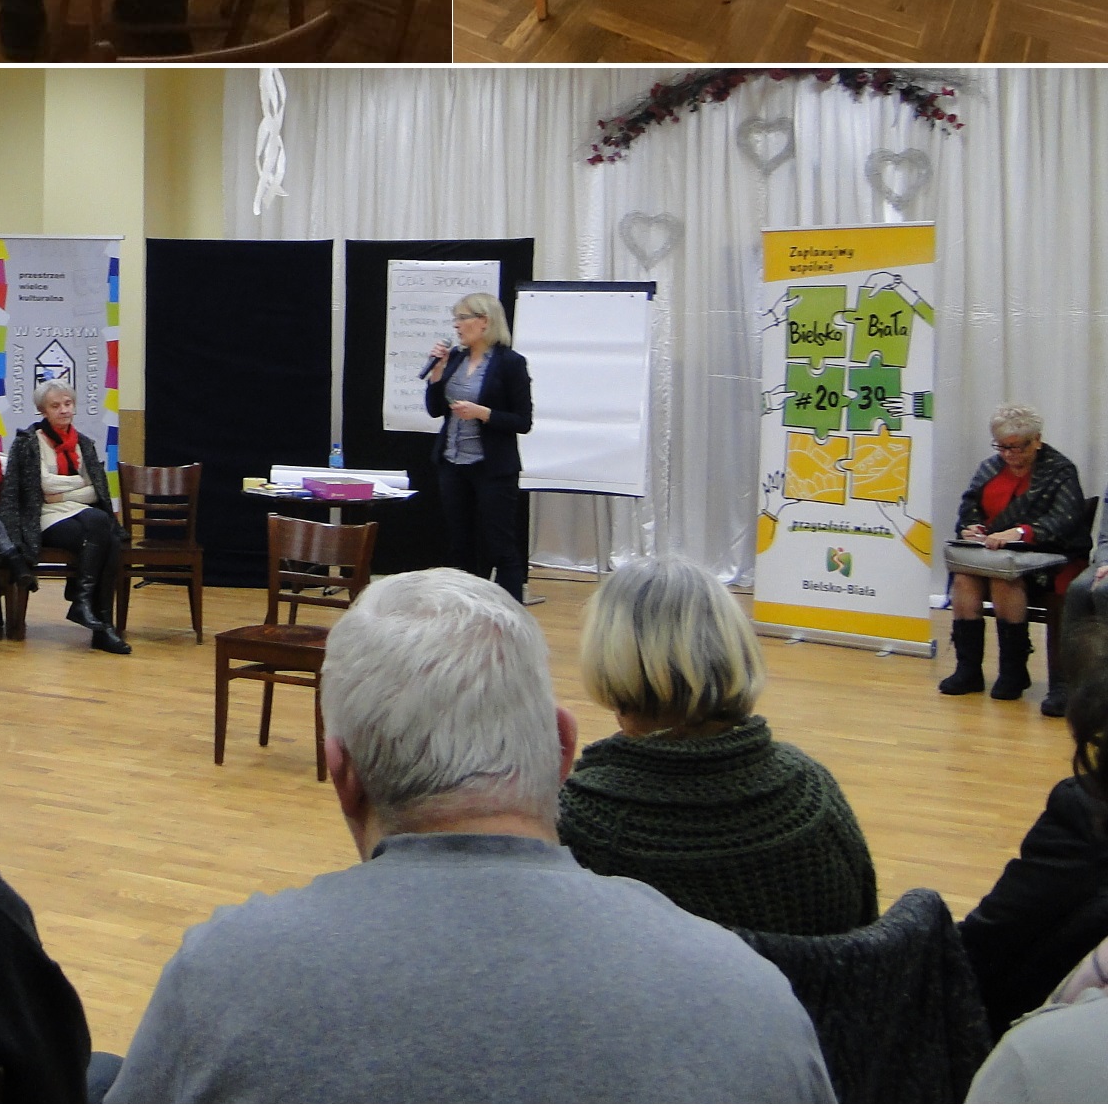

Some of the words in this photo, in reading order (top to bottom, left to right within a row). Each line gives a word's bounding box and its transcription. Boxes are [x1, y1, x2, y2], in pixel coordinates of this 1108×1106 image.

[788, 246, 855, 259] Zaplanujmy
[789, 262, 835, 275] wspólnie
[18, 283, 49, 291] wielce
[18, 294, 65, 302] kulturalna
[13, 325, 30, 337] W
[34, 326, 99, 338] STARYM
[788, 318, 843, 347] Bielsko
[867, 310, 909, 339] Biała
[12, 343, 25, 415] KULTURY
[86, 344, 99, 416] BIELSKU
[795, 384, 839, 411] #20
[857, 385, 886, 410] 30
[802, 579, 876, 598] Bielsko-Biała
